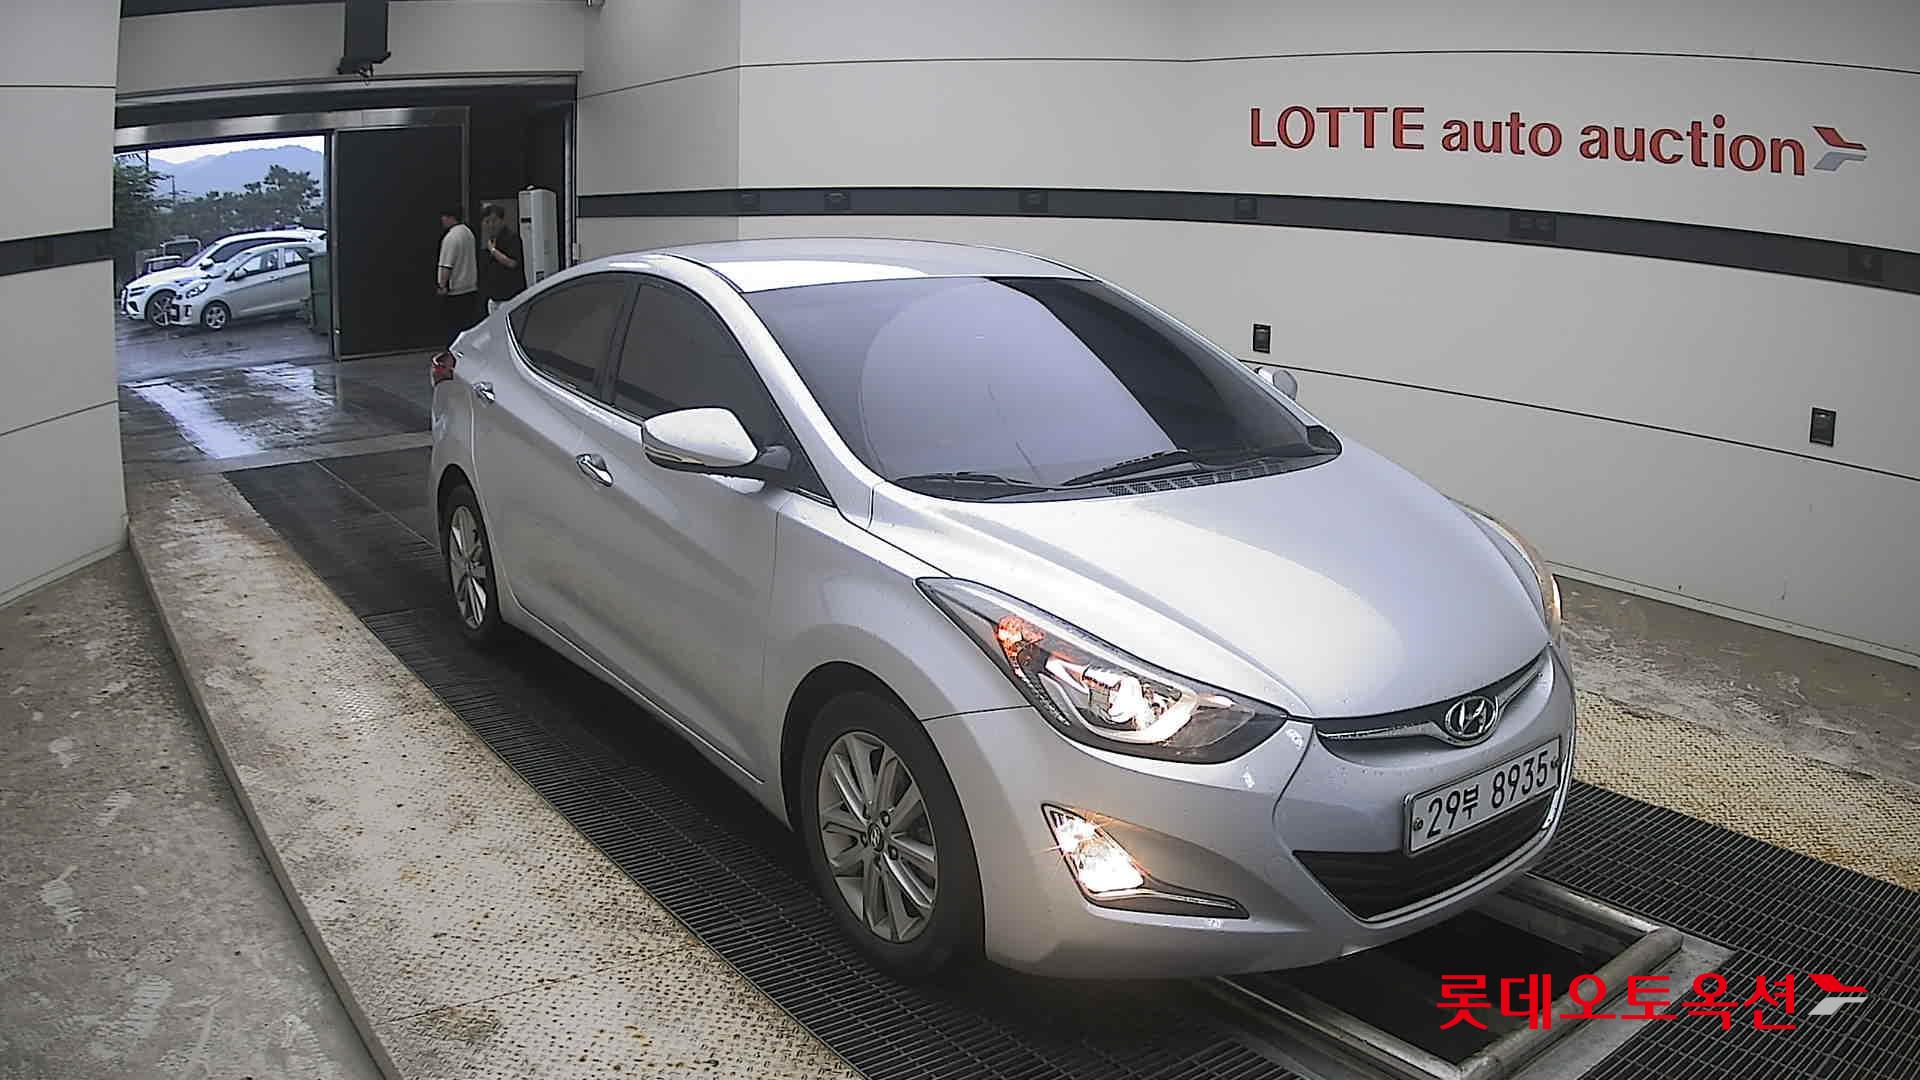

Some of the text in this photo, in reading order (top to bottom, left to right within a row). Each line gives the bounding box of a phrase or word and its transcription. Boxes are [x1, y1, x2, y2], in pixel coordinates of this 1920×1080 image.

[1250, 106, 1806, 175] LOTTE auto auction
[1427, 751, 1549, 839] 29부 8935
